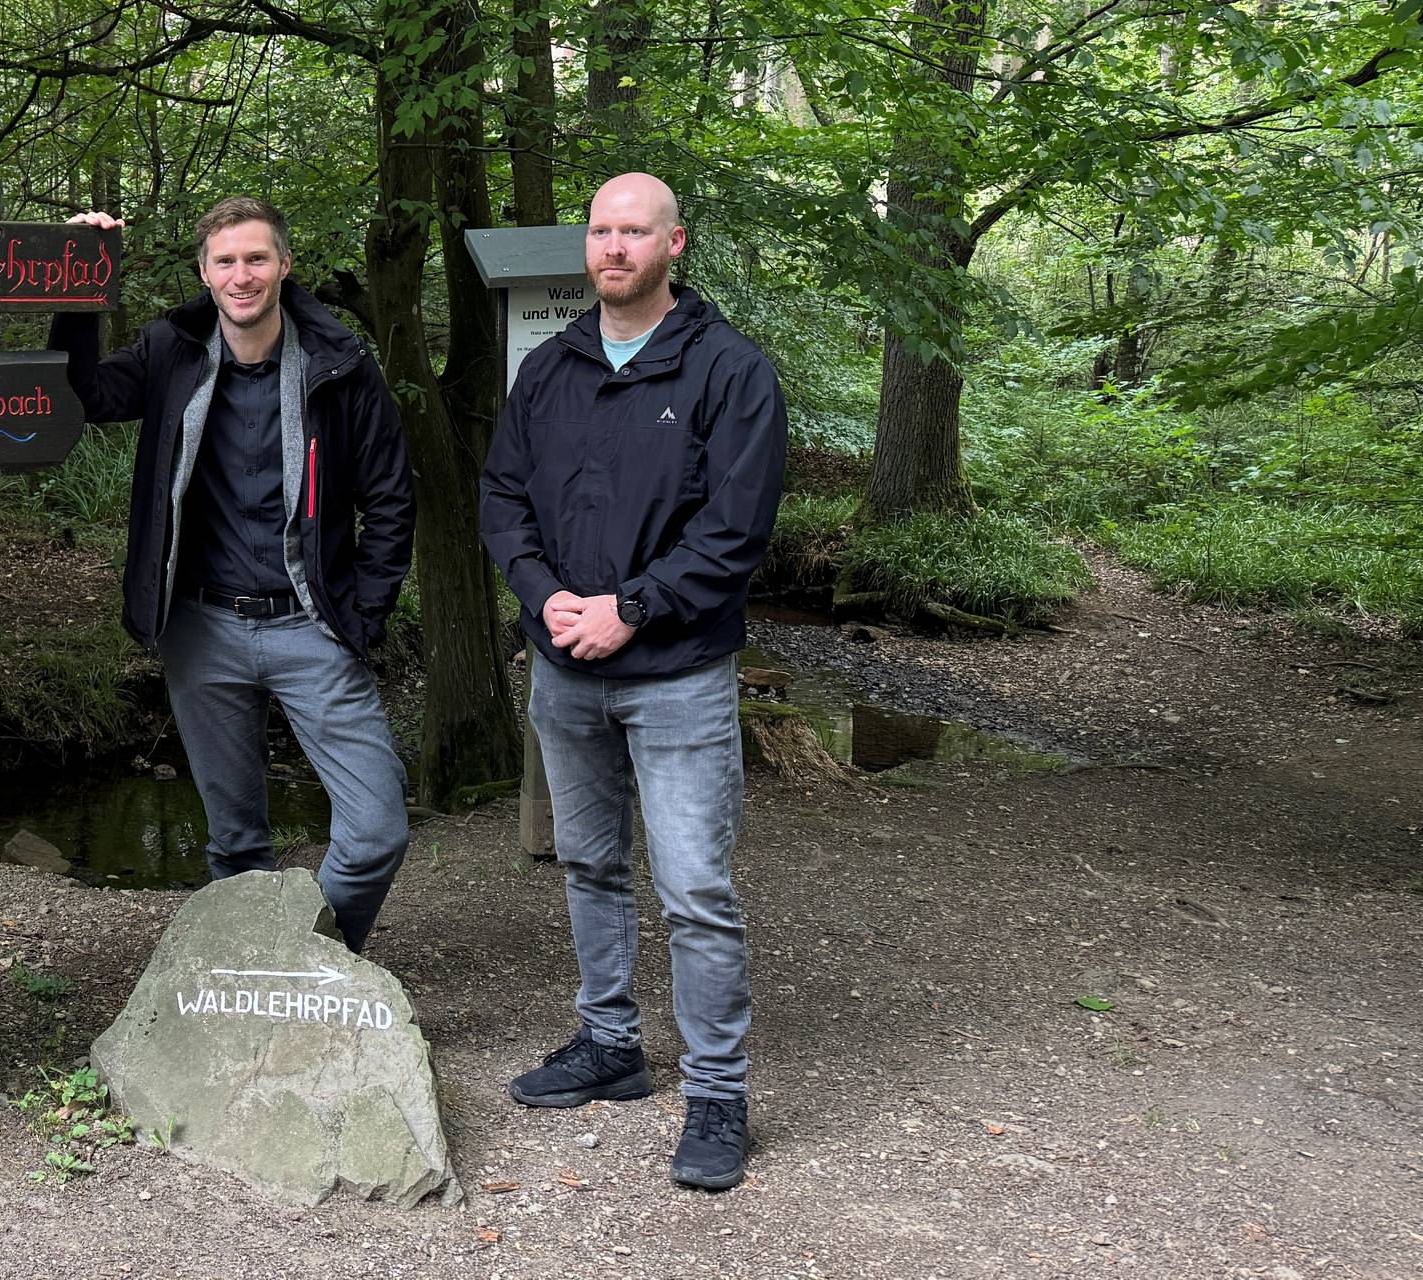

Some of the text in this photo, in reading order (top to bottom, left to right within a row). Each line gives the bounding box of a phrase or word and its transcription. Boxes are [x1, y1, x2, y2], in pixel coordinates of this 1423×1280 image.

[548, 287, 584, 300] Wald
[522, 306, 549, 320] und
[177, 989, 393, 1030] WALDLEHRPFAD
